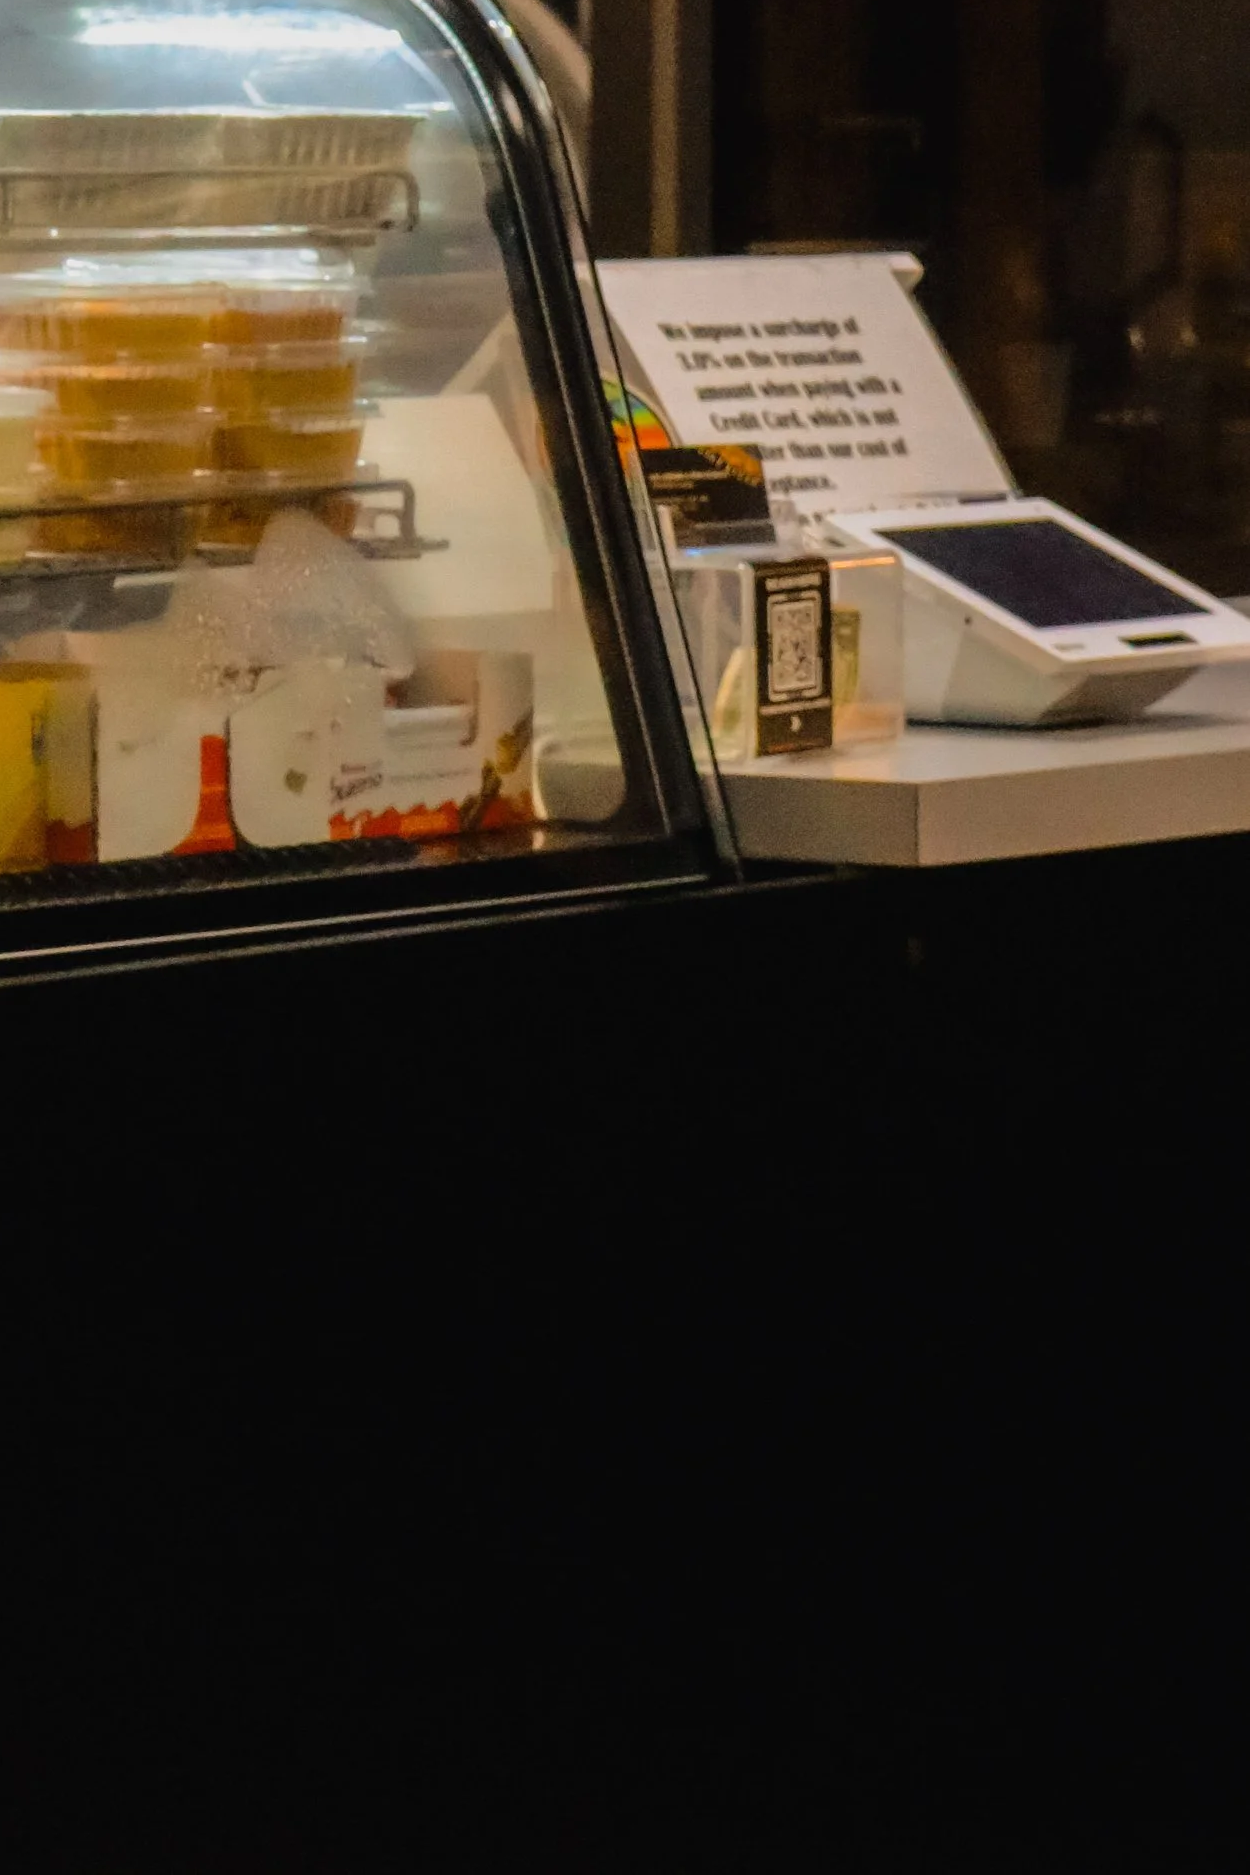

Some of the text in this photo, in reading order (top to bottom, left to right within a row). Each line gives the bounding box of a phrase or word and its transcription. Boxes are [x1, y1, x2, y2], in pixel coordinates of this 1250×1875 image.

[762, 317, 841, 338] surcharge
[772, 346, 864, 367] transaction
[709, 412, 762, 433] Credit
